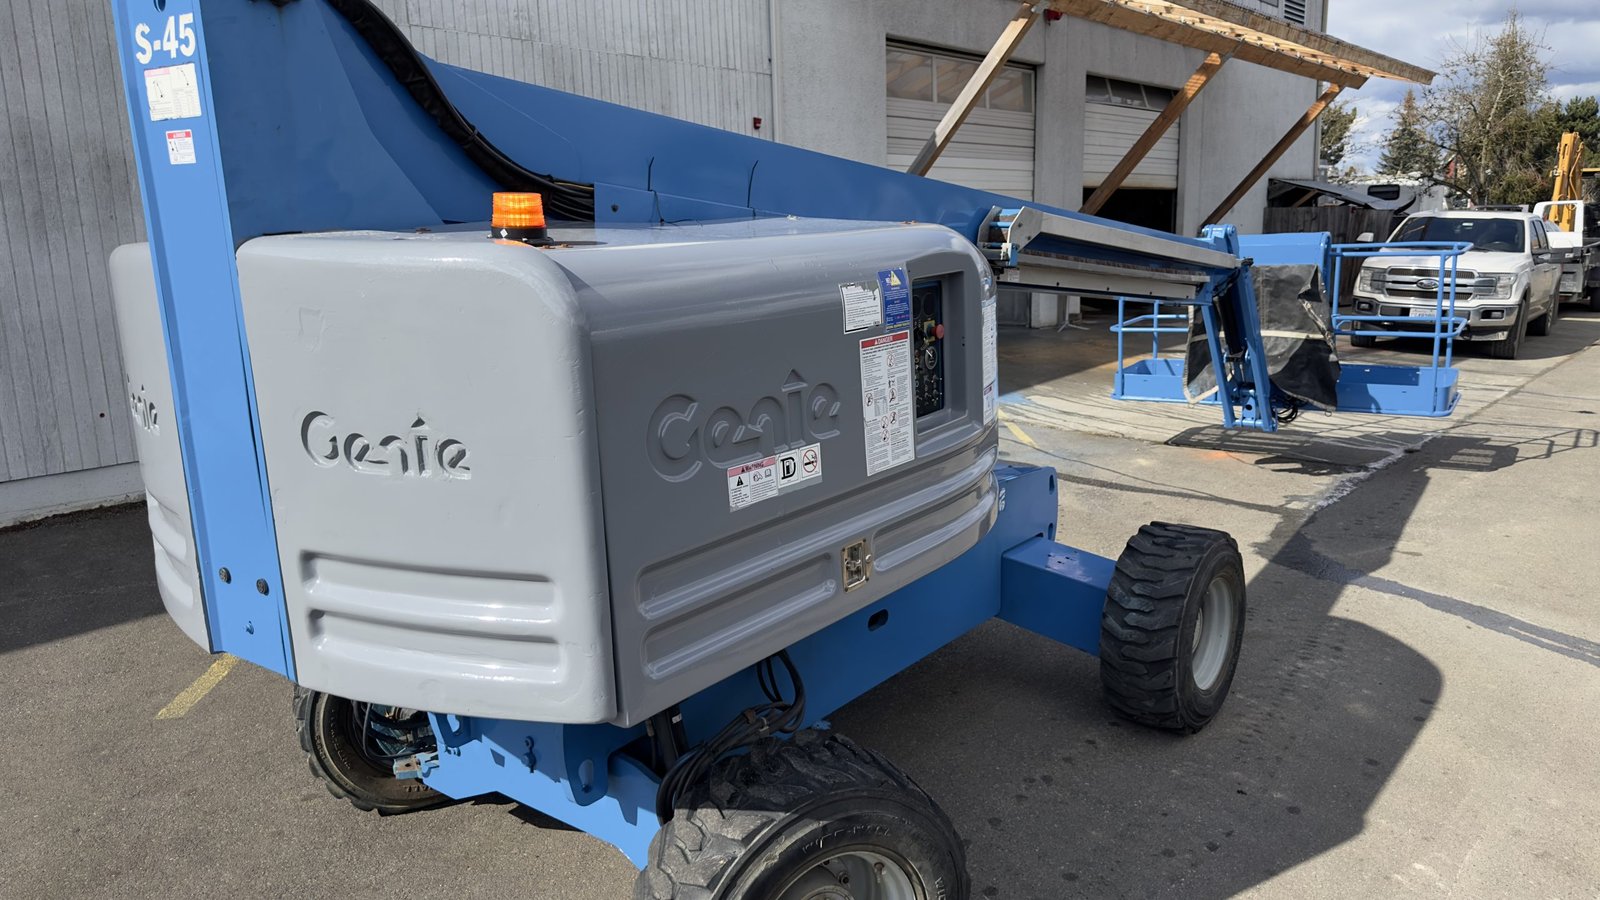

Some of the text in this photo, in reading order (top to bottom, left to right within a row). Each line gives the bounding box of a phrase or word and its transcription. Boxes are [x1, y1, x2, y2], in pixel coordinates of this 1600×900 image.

[135, 12, 196, 64] S-45
[300, 407, 472, 482] Genie
[646, 368, 841, 482] Genie
